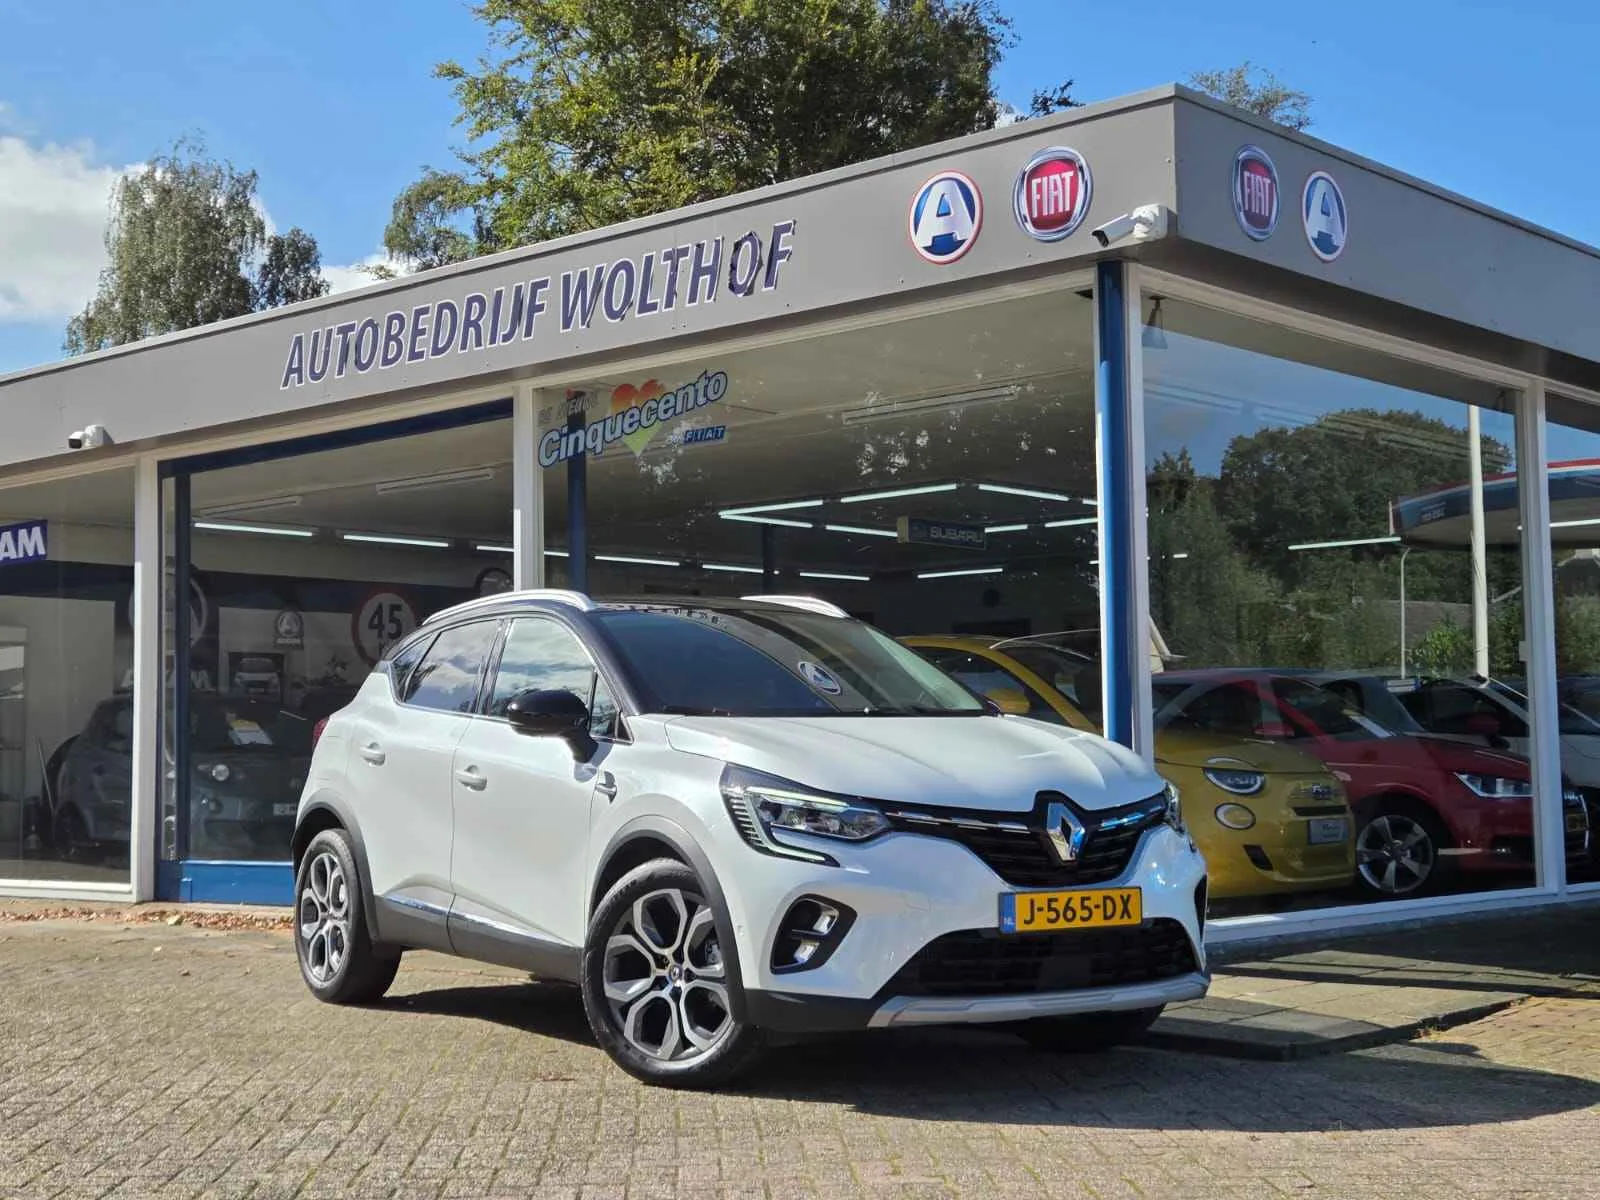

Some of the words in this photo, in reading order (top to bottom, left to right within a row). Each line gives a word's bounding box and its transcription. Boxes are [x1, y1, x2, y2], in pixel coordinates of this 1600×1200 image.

[1031, 171, 1074, 218] FIAT
[1243, 171, 1271, 217] FIAT
[280, 276, 551, 390] AUTOBEDRIJF
[559, 218, 797, 333] WOLTHOF
[538, 369, 728, 469] Cinquecento
[685, 427, 725, 443] FIAT
[930, 526, 983, 543] SUBARU
[368, 602, 403, 640] 45
[1023, 894, 1132, 925] J-565-DX
